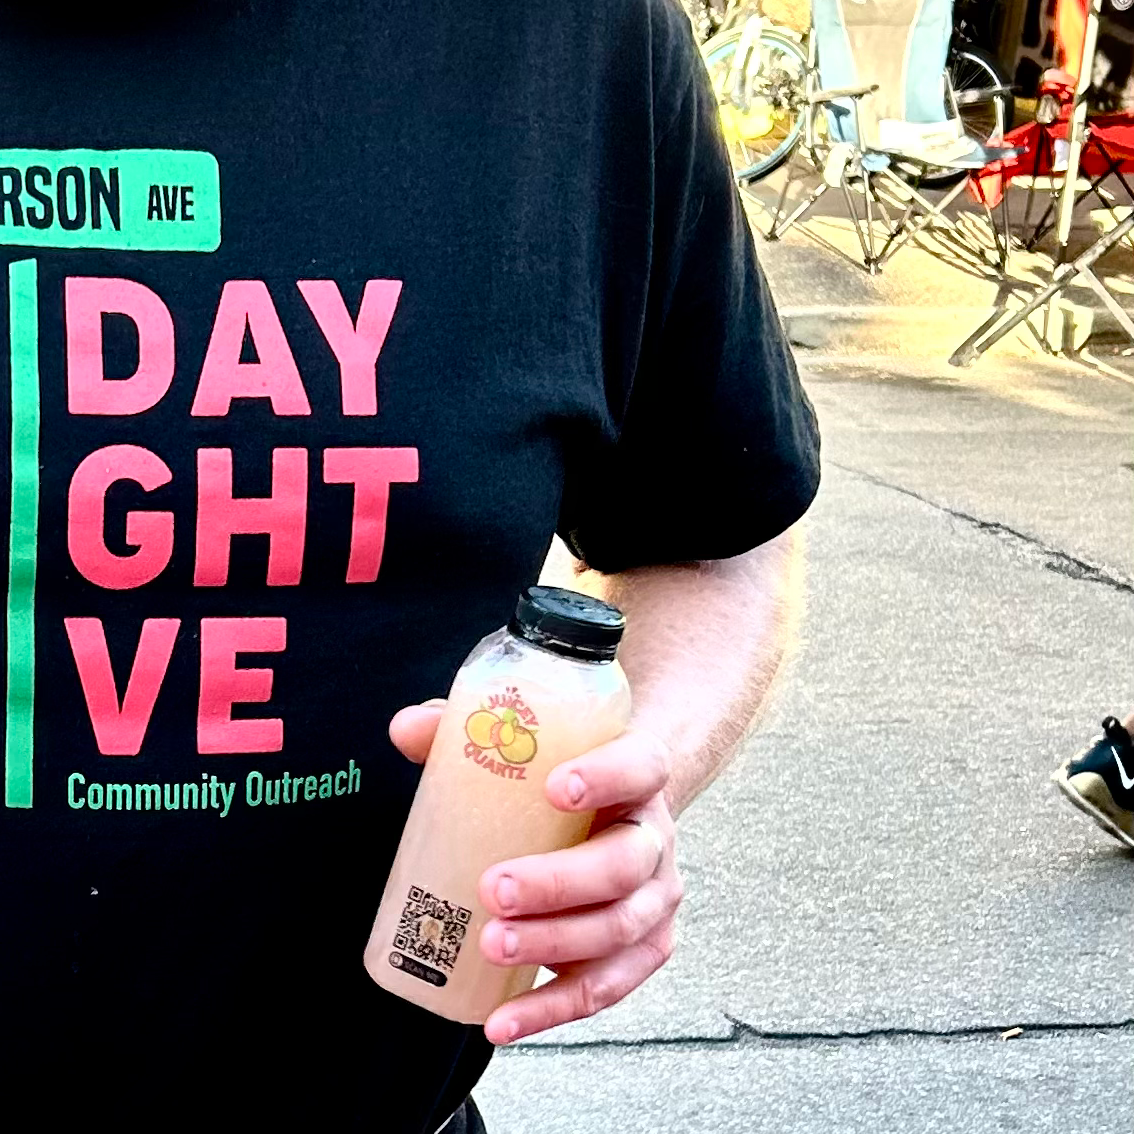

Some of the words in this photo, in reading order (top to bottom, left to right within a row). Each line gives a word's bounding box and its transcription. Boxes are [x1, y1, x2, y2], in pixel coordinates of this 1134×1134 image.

[147, 185, 195, 221] AVE
[463, 742, 526, 779] QUARTZ
[67, 772, 236, 817] Community
[245, 759, 362, 806] Outreach
